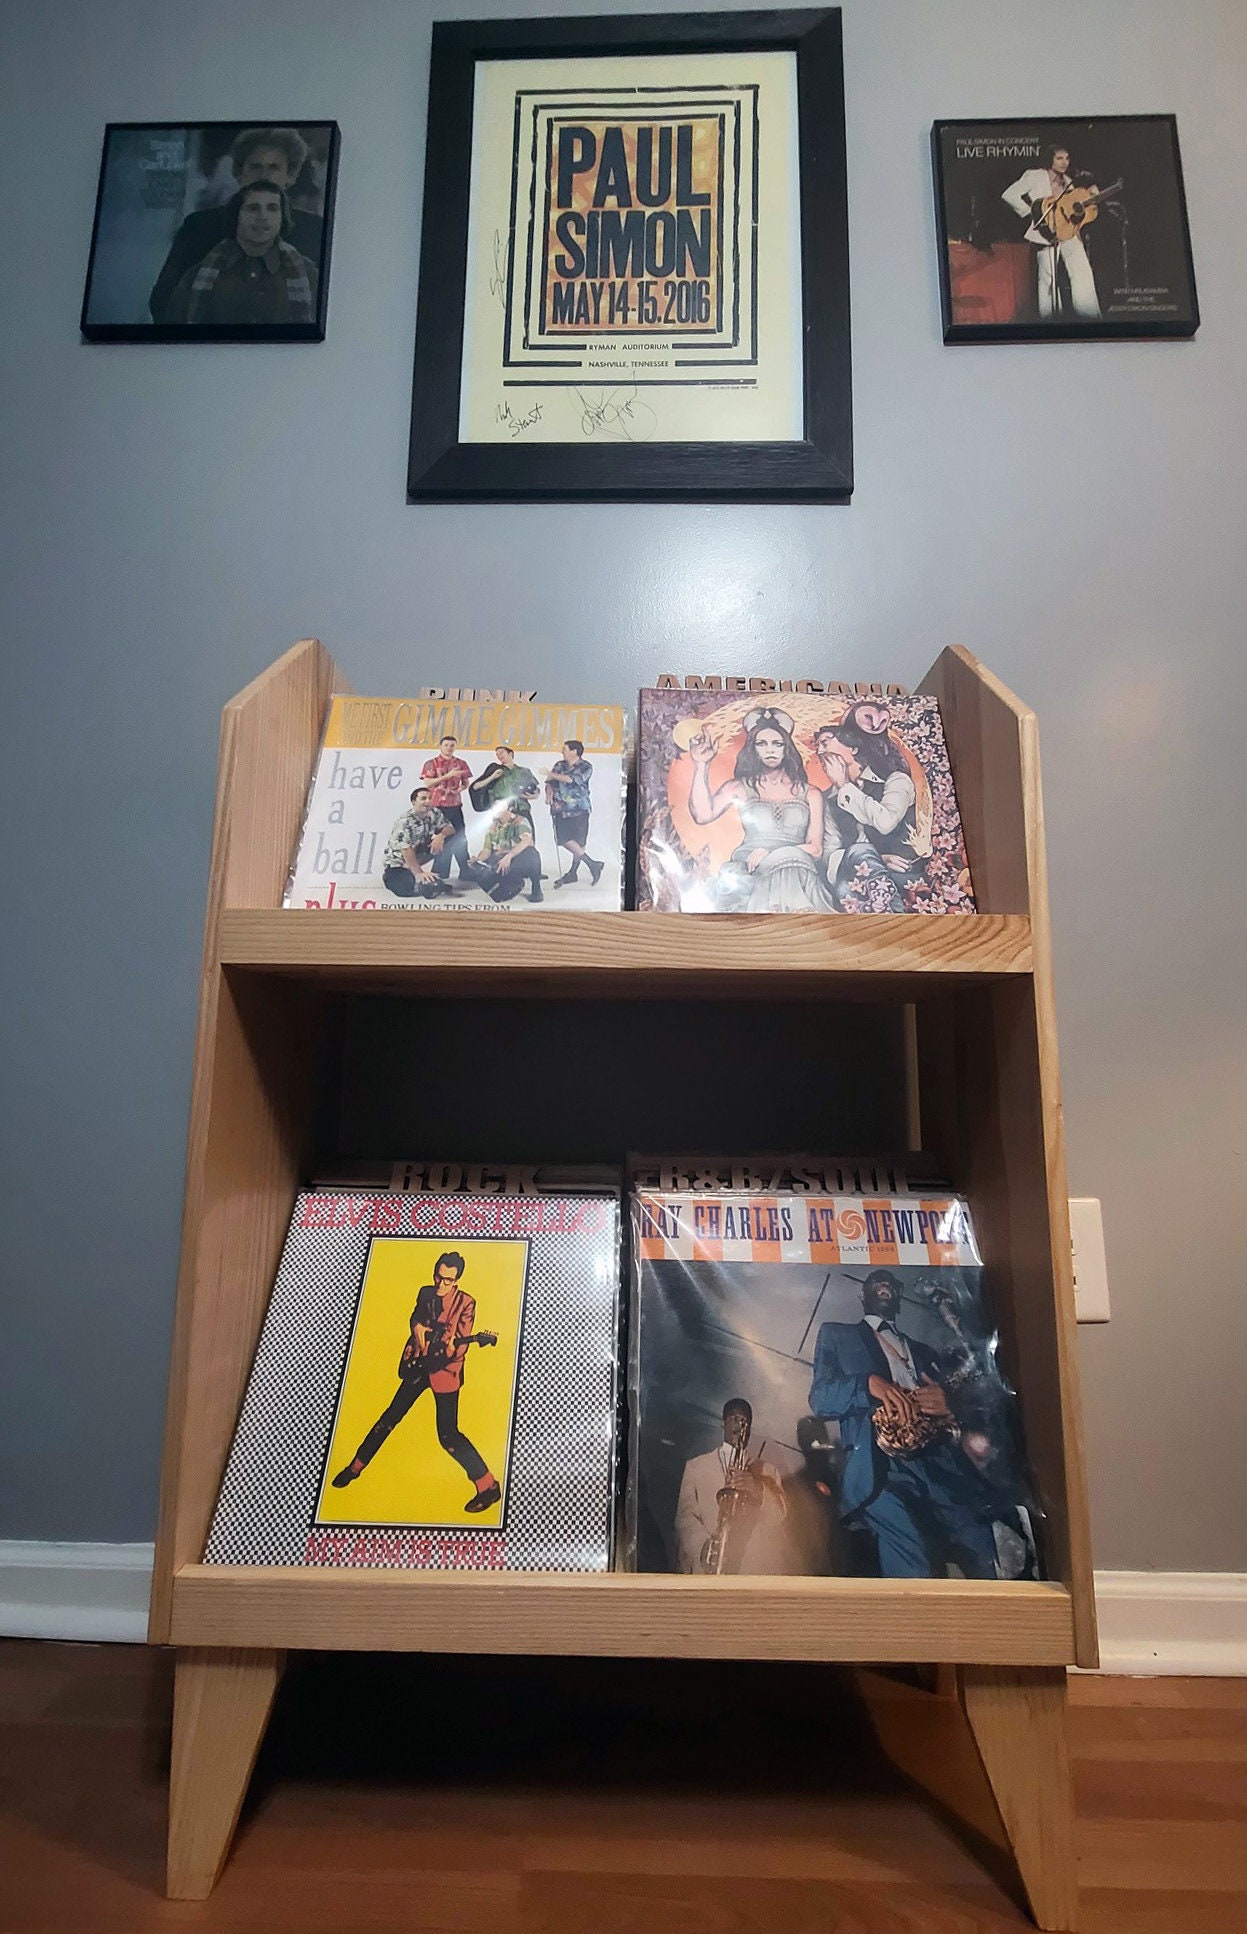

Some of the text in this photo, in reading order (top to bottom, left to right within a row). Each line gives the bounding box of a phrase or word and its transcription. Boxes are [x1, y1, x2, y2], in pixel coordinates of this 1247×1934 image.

[557, 125, 711, 208] PAUL
[956, 145, 985, 158] LIVE
[554, 209, 711, 279] SIMON
[551, 281, 604, 325] MAY
[588, 360, 669, 369] NASHVILLE, TENNESSEE
[589, 343, 669, 351] RYMAN AUDITORIUM
[392, 702, 615, 750] GIMME GIMMES
[328, 752, 403, 791] have
[328, 799, 345, 824] a
[312, 831, 378, 875] ball
[390, 1161, 540, 1195] ROCK
[300, 1198, 608, 1233] ELVIS COSTELLO
[640, 1204, 970, 1245] RAY CHARLES AT NEWPO
[435, 1540, 507, 1566] TRUE
